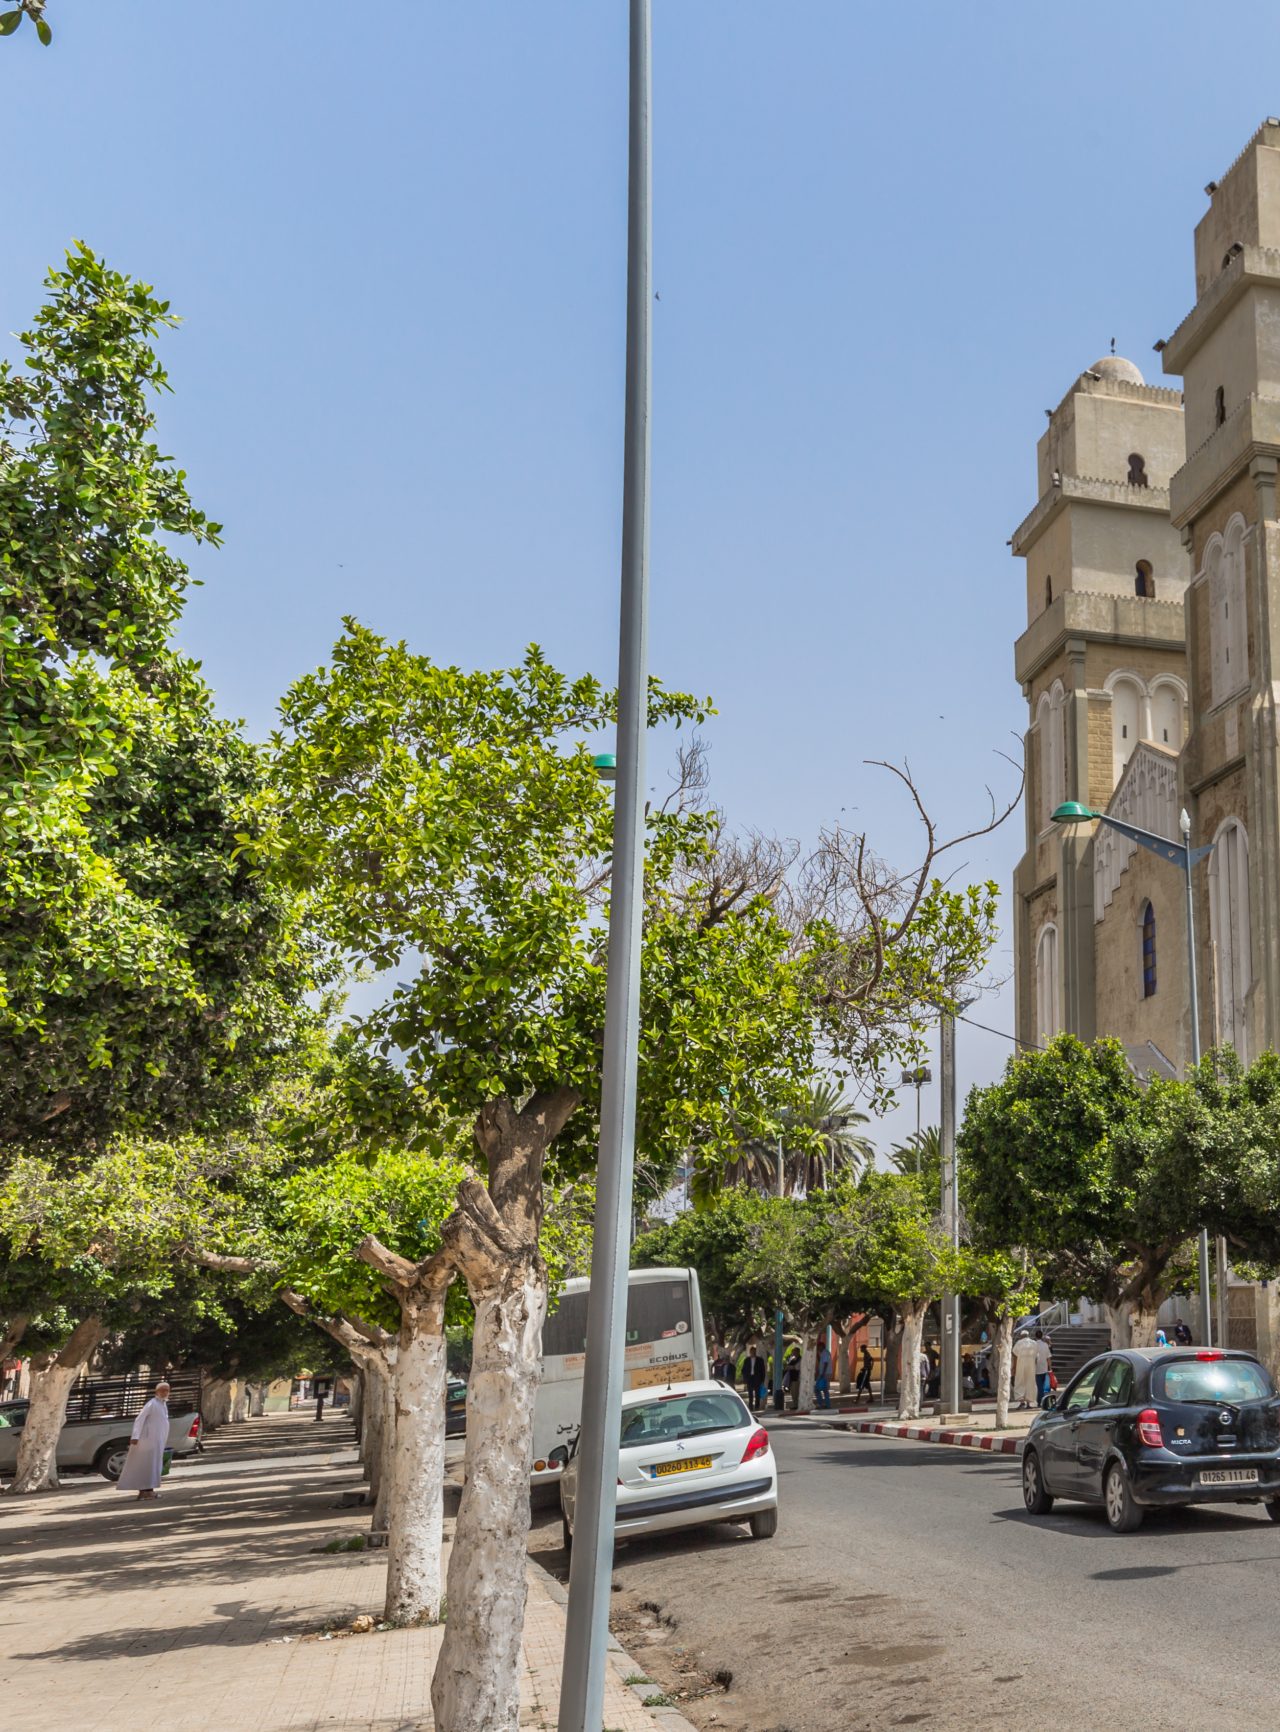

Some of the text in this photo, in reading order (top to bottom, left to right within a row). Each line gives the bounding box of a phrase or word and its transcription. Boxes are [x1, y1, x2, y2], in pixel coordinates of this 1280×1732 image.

[649, 1353, 688, 1364] ECOBUS
[656, 1463, 681, 1474] 00260
[700, 1457, 711, 1466] 46
[1202, 1470, 1256, 1482] 01265 111 46
